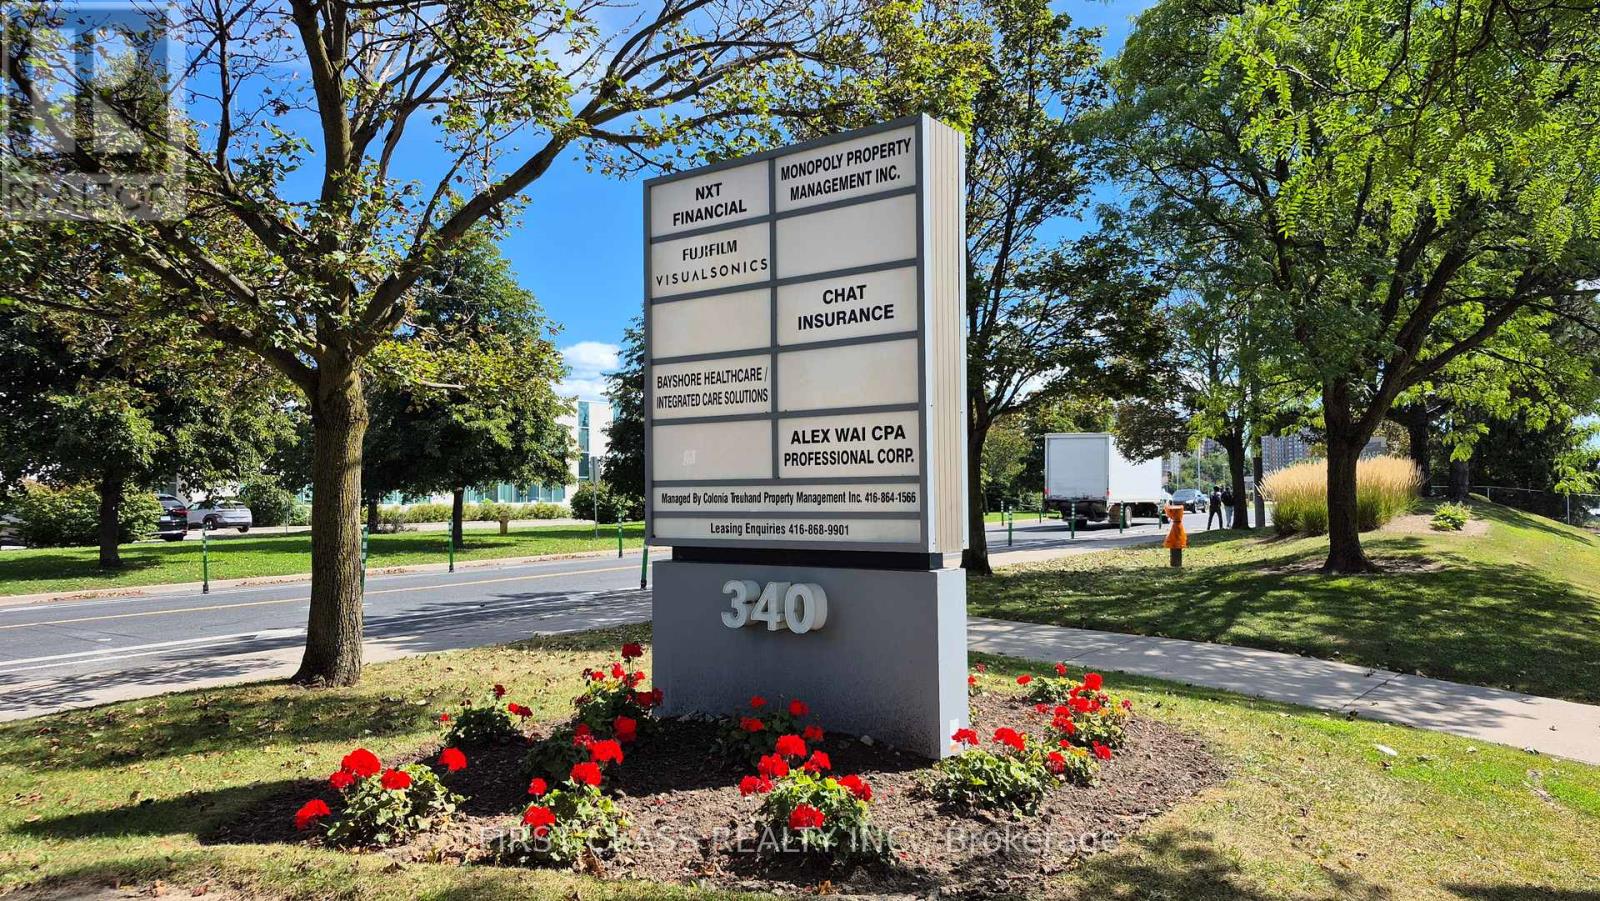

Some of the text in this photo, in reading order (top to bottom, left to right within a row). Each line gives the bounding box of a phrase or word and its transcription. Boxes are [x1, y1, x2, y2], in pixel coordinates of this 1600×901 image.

[780, 137, 912, 180] MONOPOLY PROPERTY
[695, 182, 722, 201] NXT
[790, 165, 900, 201] MANAGEMENT INC.
[673, 199, 746, 226] FINANCIAL
[682, 240, 737, 261] FUJIFILM
[656, 258, 768, 287] VISUALSONICS
[822, 284, 867, 304] CHAT
[797, 304, 894, 330] INSURANCE
[657, 371, 702, 389] BAYSHORE
[704, 367, 762, 384] HEALTHCARE
[657, 389, 768, 409] INTEGRATED CARE SOLUTIONS
[791, 425, 905, 444] ALEX WAI CPA
[784, 448, 914, 466] PROFESSIONAL CORP.
[661, 491, 916, 505] Managed By Colonia Treuhand Property Management Inc. 416-864-1566
[711, 522, 849, 536] Leasing Enquiries 416-868-9901
[722, 580, 828, 634] 340
